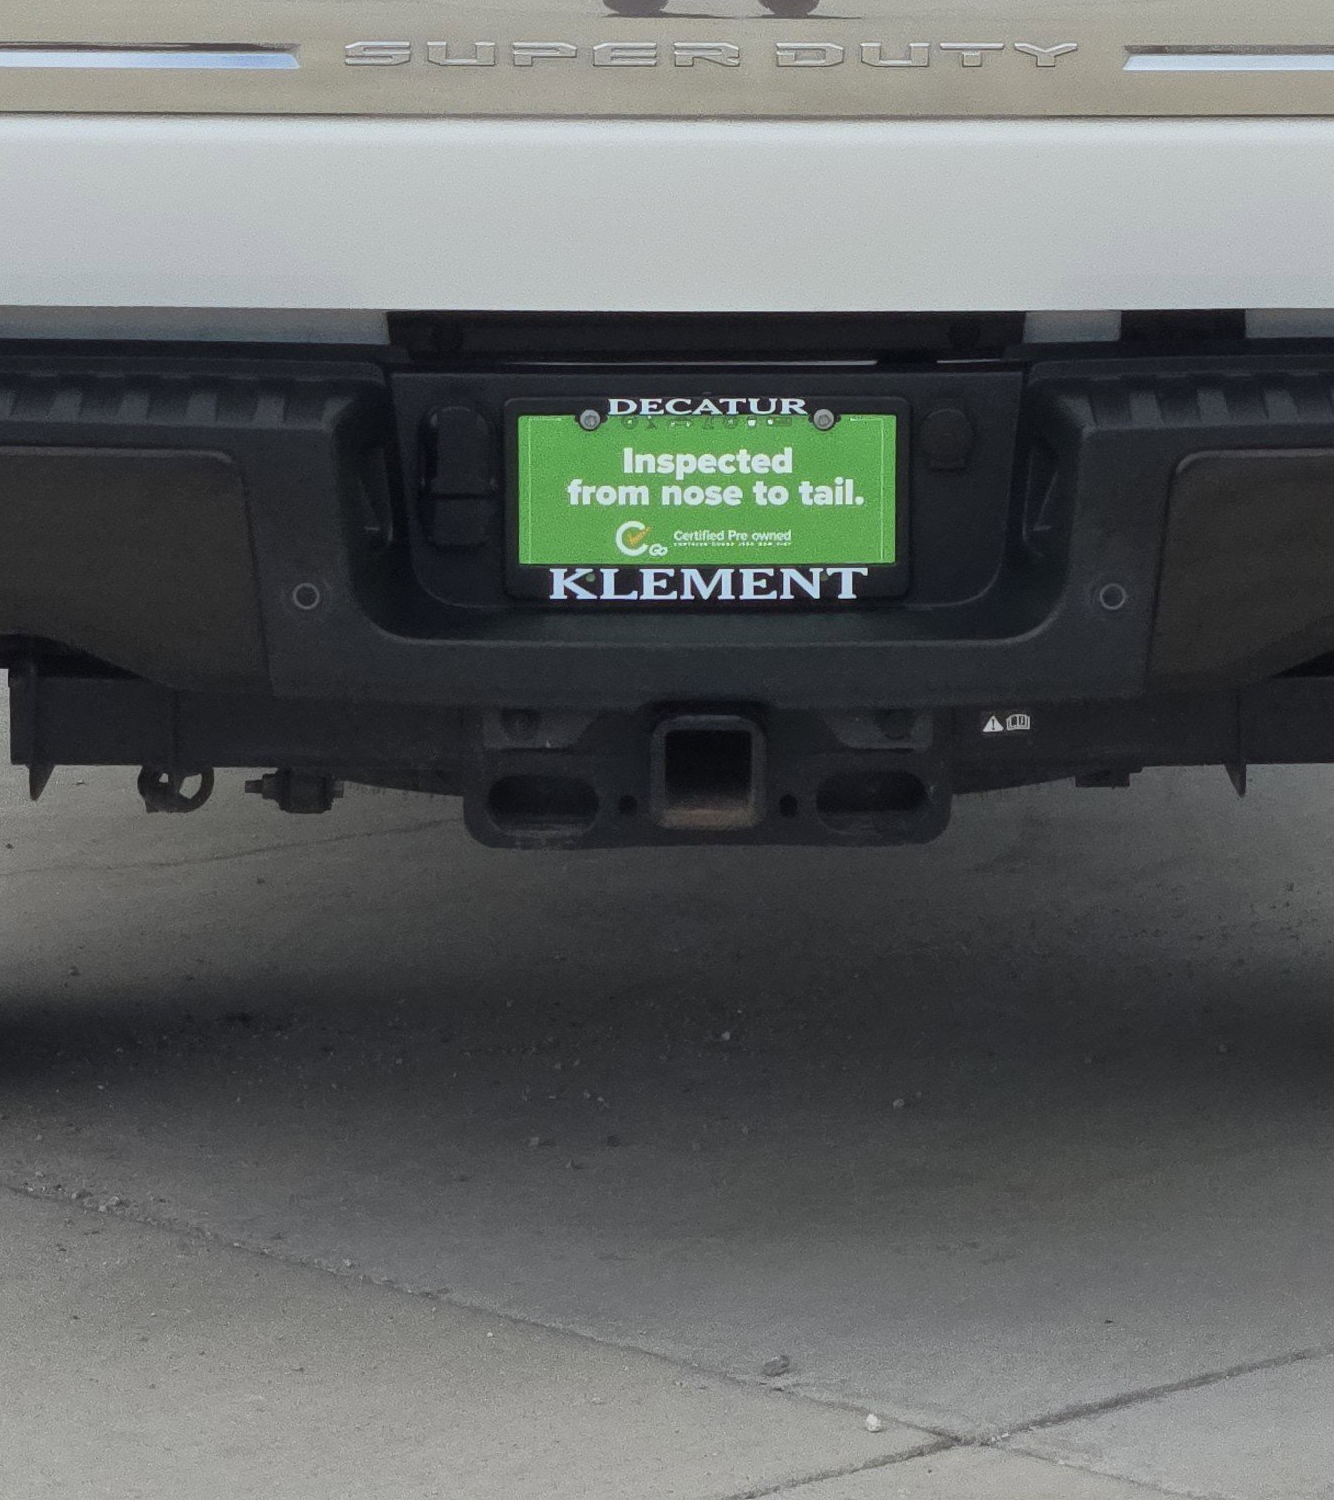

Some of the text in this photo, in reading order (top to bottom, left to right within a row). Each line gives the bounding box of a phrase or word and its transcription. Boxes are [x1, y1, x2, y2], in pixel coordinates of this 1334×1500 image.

[343, 40, 1080, 68] SUPER DUTY
[607, 397, 809, 416] DECATUR
[622, 446, 793, 480] Inspected
[566, 477, 865, 506] from nose to tail.
[673, 529, 792, 542] Certified Pre owned
[548, 567, 869, 600] KLEMENT
